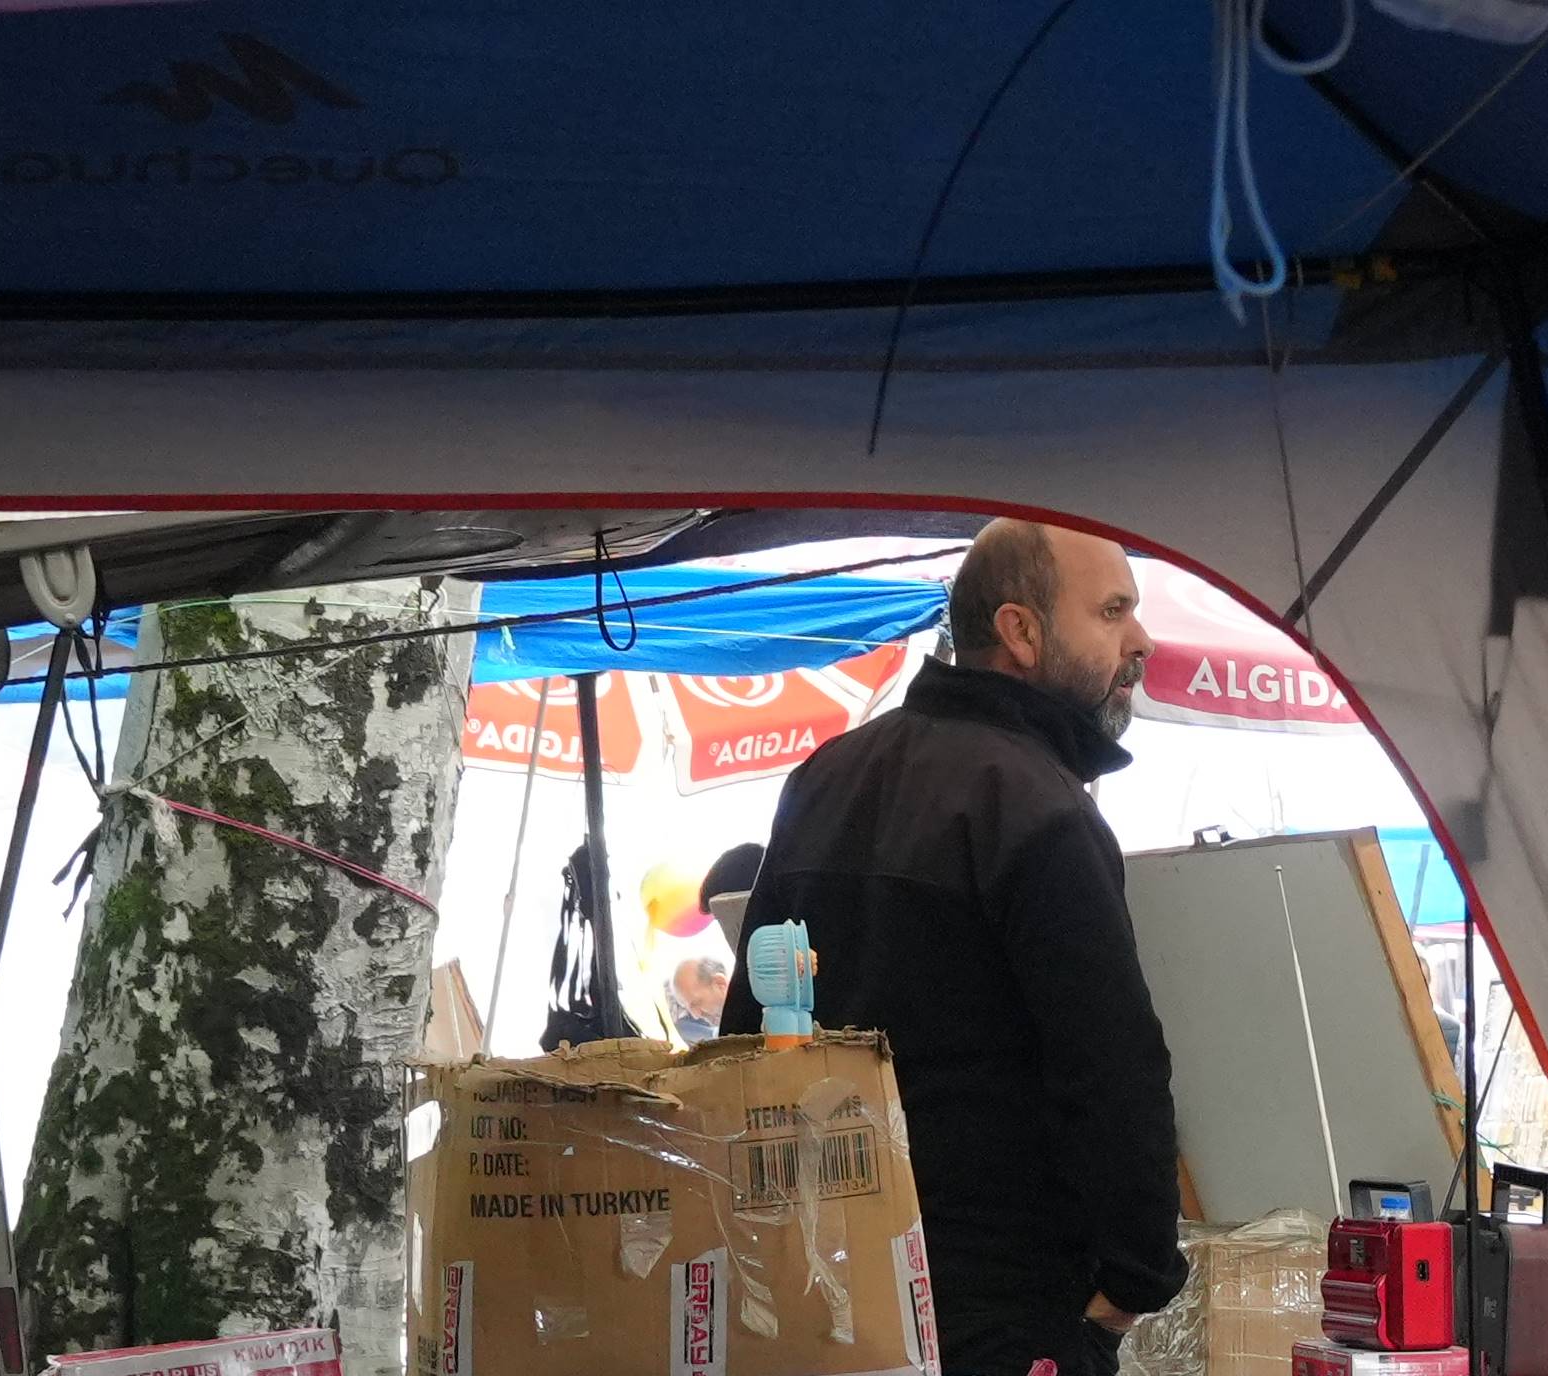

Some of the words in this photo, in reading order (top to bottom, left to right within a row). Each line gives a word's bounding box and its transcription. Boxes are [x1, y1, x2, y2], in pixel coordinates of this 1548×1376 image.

[470, 1115, 493, 1138] LOT
[499, 1116, 528, 1140] NO:
[484, 1152, 530, 1177] DATE:
[469, 1193, 534, 1218] MADE
[540, 1193, 564, 1218] IN
